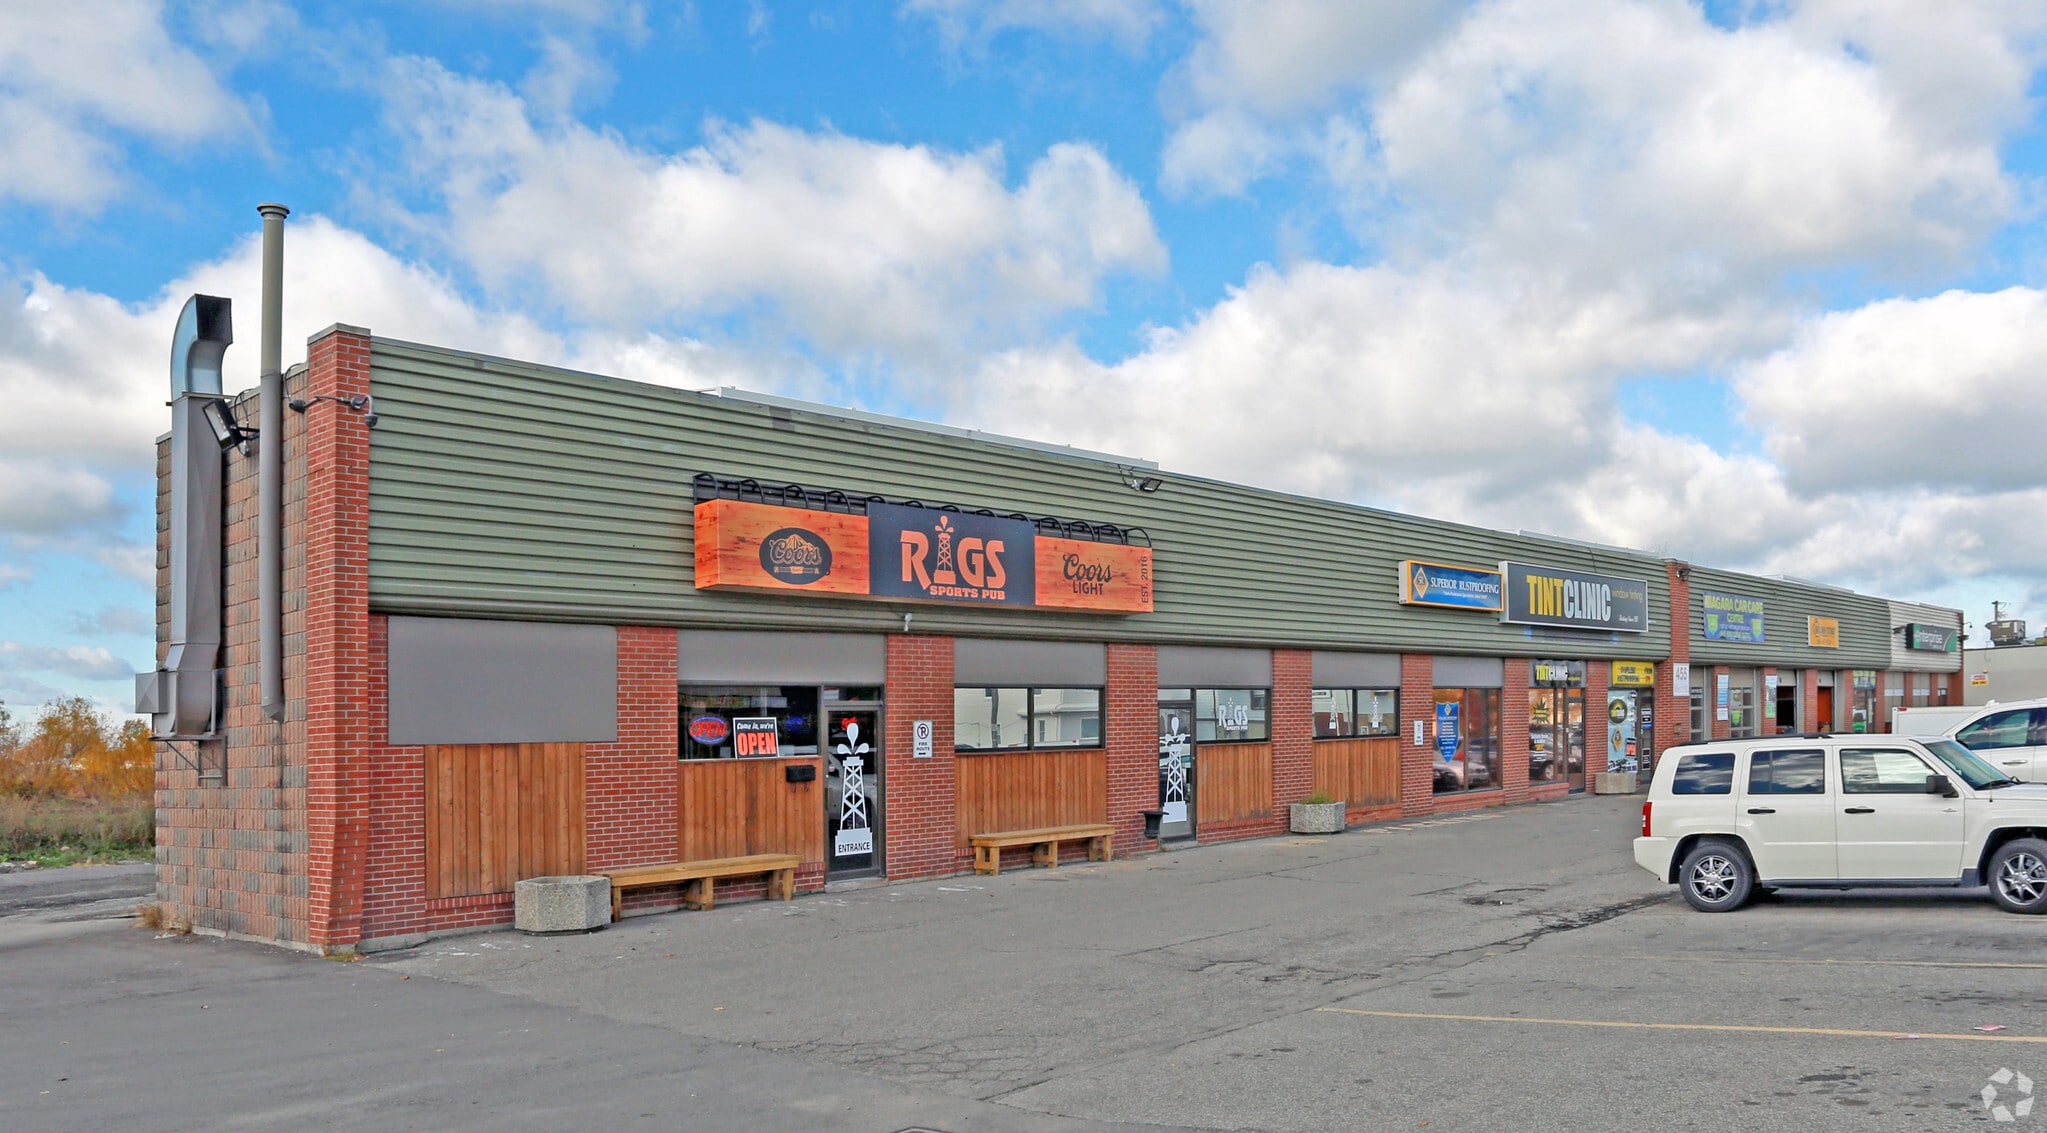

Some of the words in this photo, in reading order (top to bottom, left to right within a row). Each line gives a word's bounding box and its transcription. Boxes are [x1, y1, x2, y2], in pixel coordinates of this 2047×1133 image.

[769, 538, 822, 566] Coors
[900, 522, 1006, 590] RIGS
[1062, 553, 1112, 583] Coors
[1141, 555, 1149, 580] 2016
[929, 585, 978, 598] SPORTS
[982, 589, 1005, 600] PUB
[1072, 581, 1104, 595] LIGHT
[1141, 583, 1149, 604] EST.
[1430, 576, 1458, 590] SUPERIOR
[1459, 580, 1499, 594] RUSTPROOFING
[1704, 595, 1734, 611] NIAGARA
[1734, 598, 1748, 613] CAR
[1747, 600, 1764, 615] CARE
[1675, 667, 1688, 681] 455
[1218, 702, 1248, 728] RIGS
[689, 721, 729, 738] OPEN
[737, 732, 777, 756] OPEN
[838, 841, 871, 853] ENTRANCE
